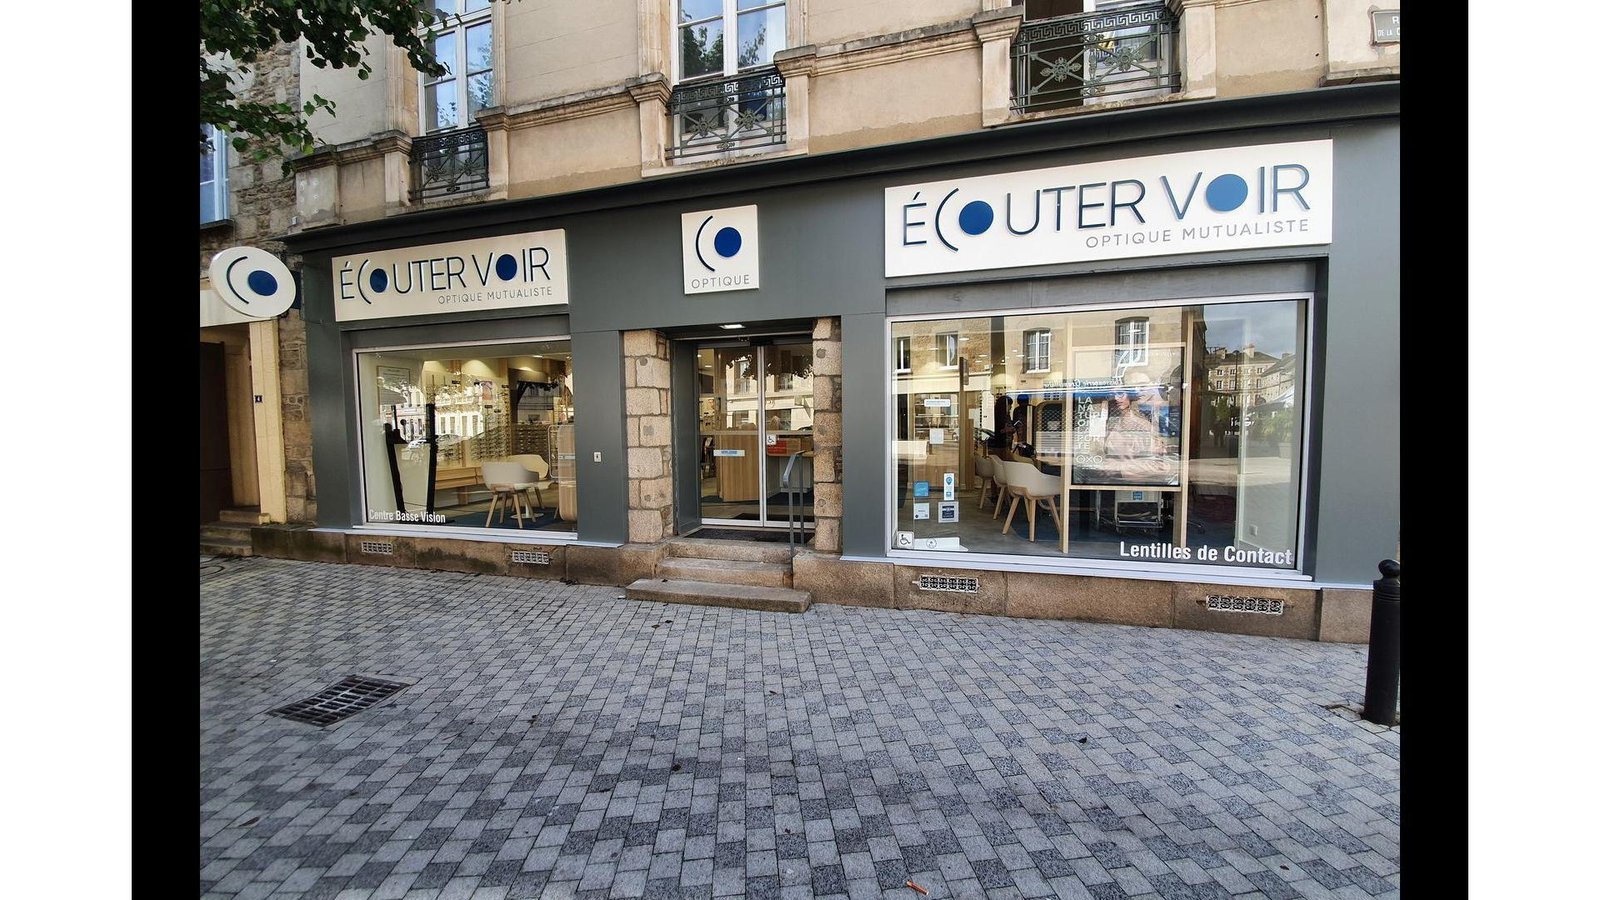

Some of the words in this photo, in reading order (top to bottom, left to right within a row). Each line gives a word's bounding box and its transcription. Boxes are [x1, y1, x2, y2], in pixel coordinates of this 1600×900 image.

[1160, 164, 1311, 221] VOIR
[1085, 228, 1171, 249] OPTIQUE
[1182, 219, 1309, 241] MUTUALISTE
[472, 247, 551, 286] VOIR
[691, 274, 750, 289] OPTIQUE
[438, 292, 483, 304] OPTIQUE
[487, 286, 553, 300] MUTUALISTE
[369, 509, 394, 520] Centre
[396, 510, 419, 522] Basse
[420, 511, 446, 523] Vision
[1120, 541, 1191, 560] Lentilles
[1197, 544, 1218, 561] de
[1224, 545, 1293, 565] Contact
